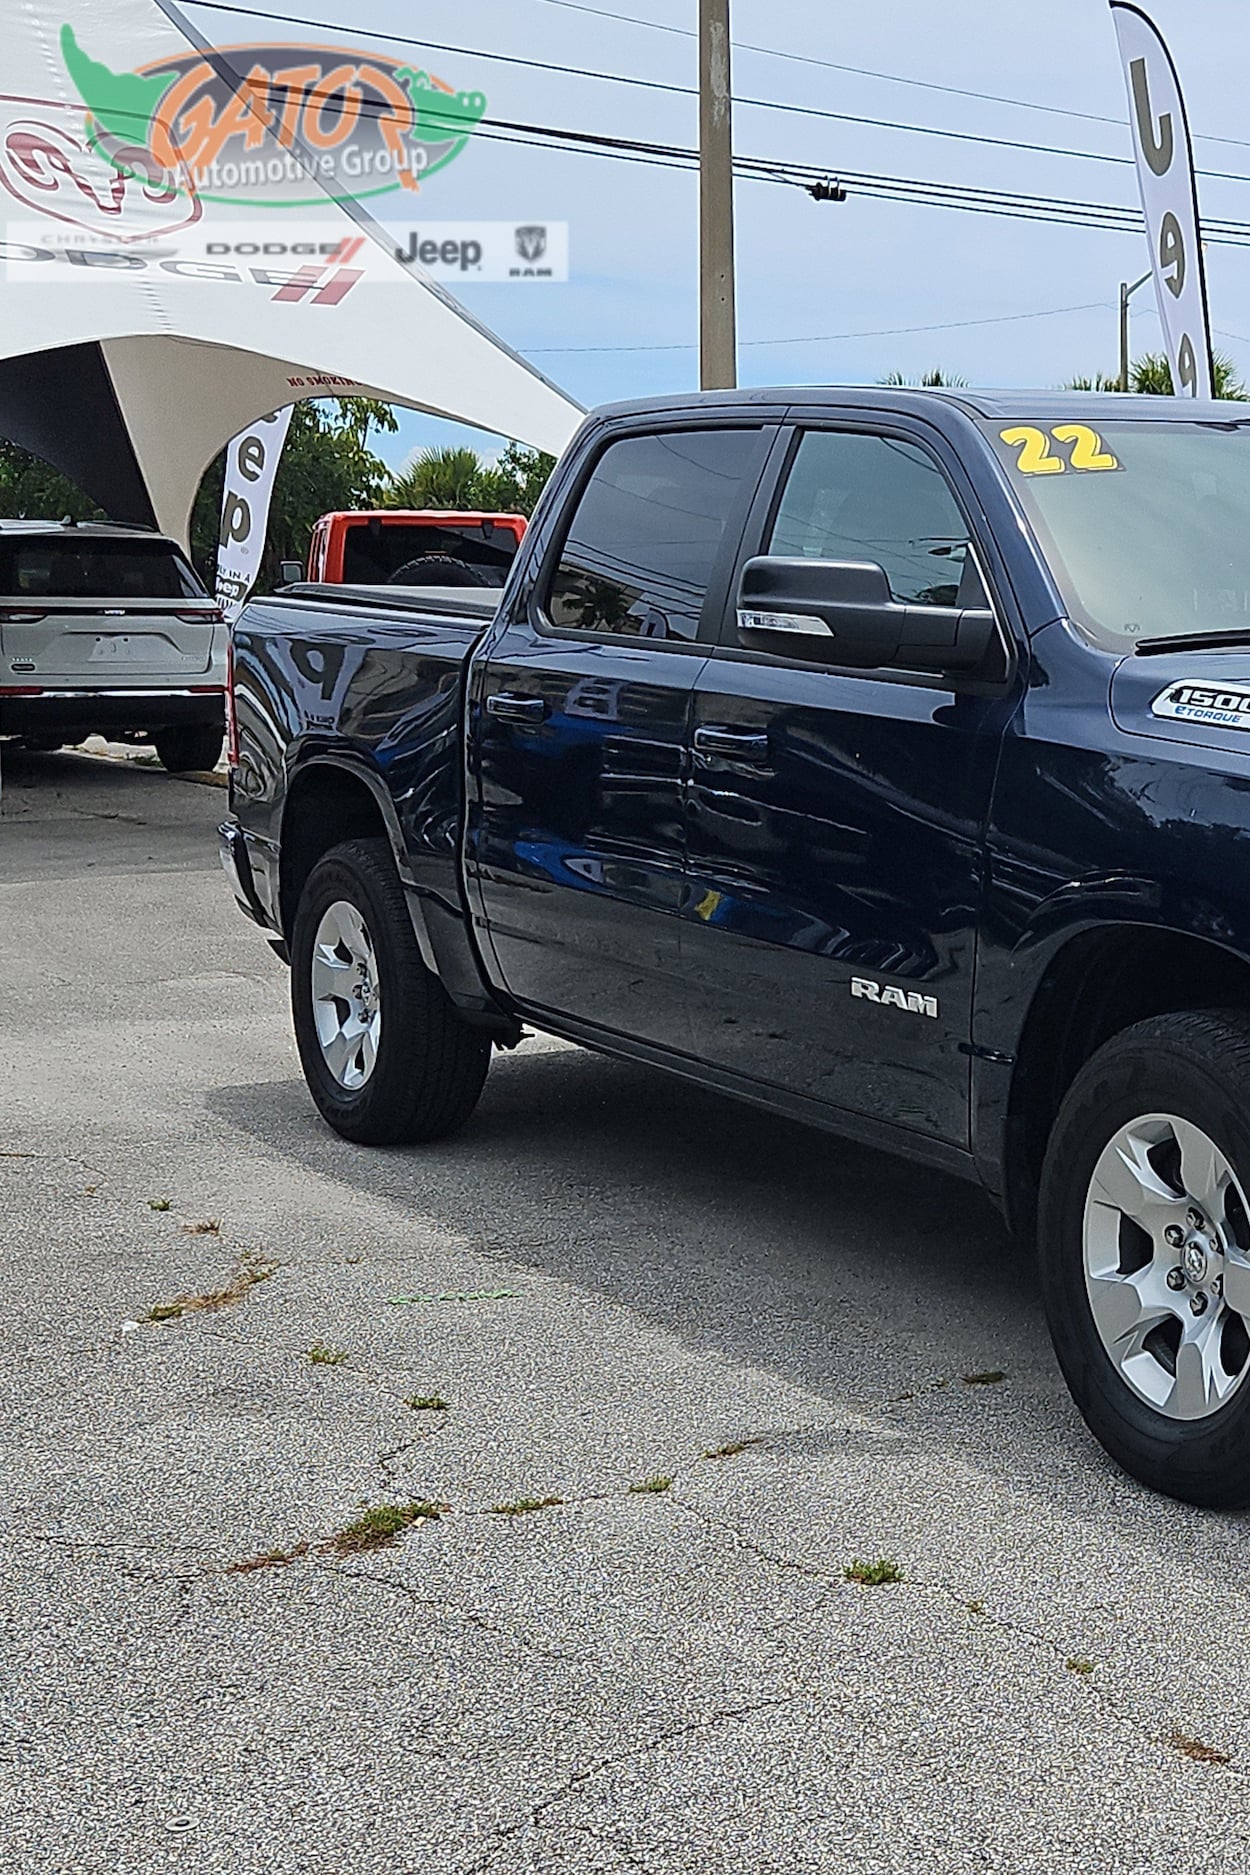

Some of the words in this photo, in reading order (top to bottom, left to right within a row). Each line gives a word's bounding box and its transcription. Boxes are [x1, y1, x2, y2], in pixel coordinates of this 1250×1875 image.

[286, 377, 304, 387] NO
[1000, 424, 1118, 476] 22
[851, 976, 938, 1019] RAM
